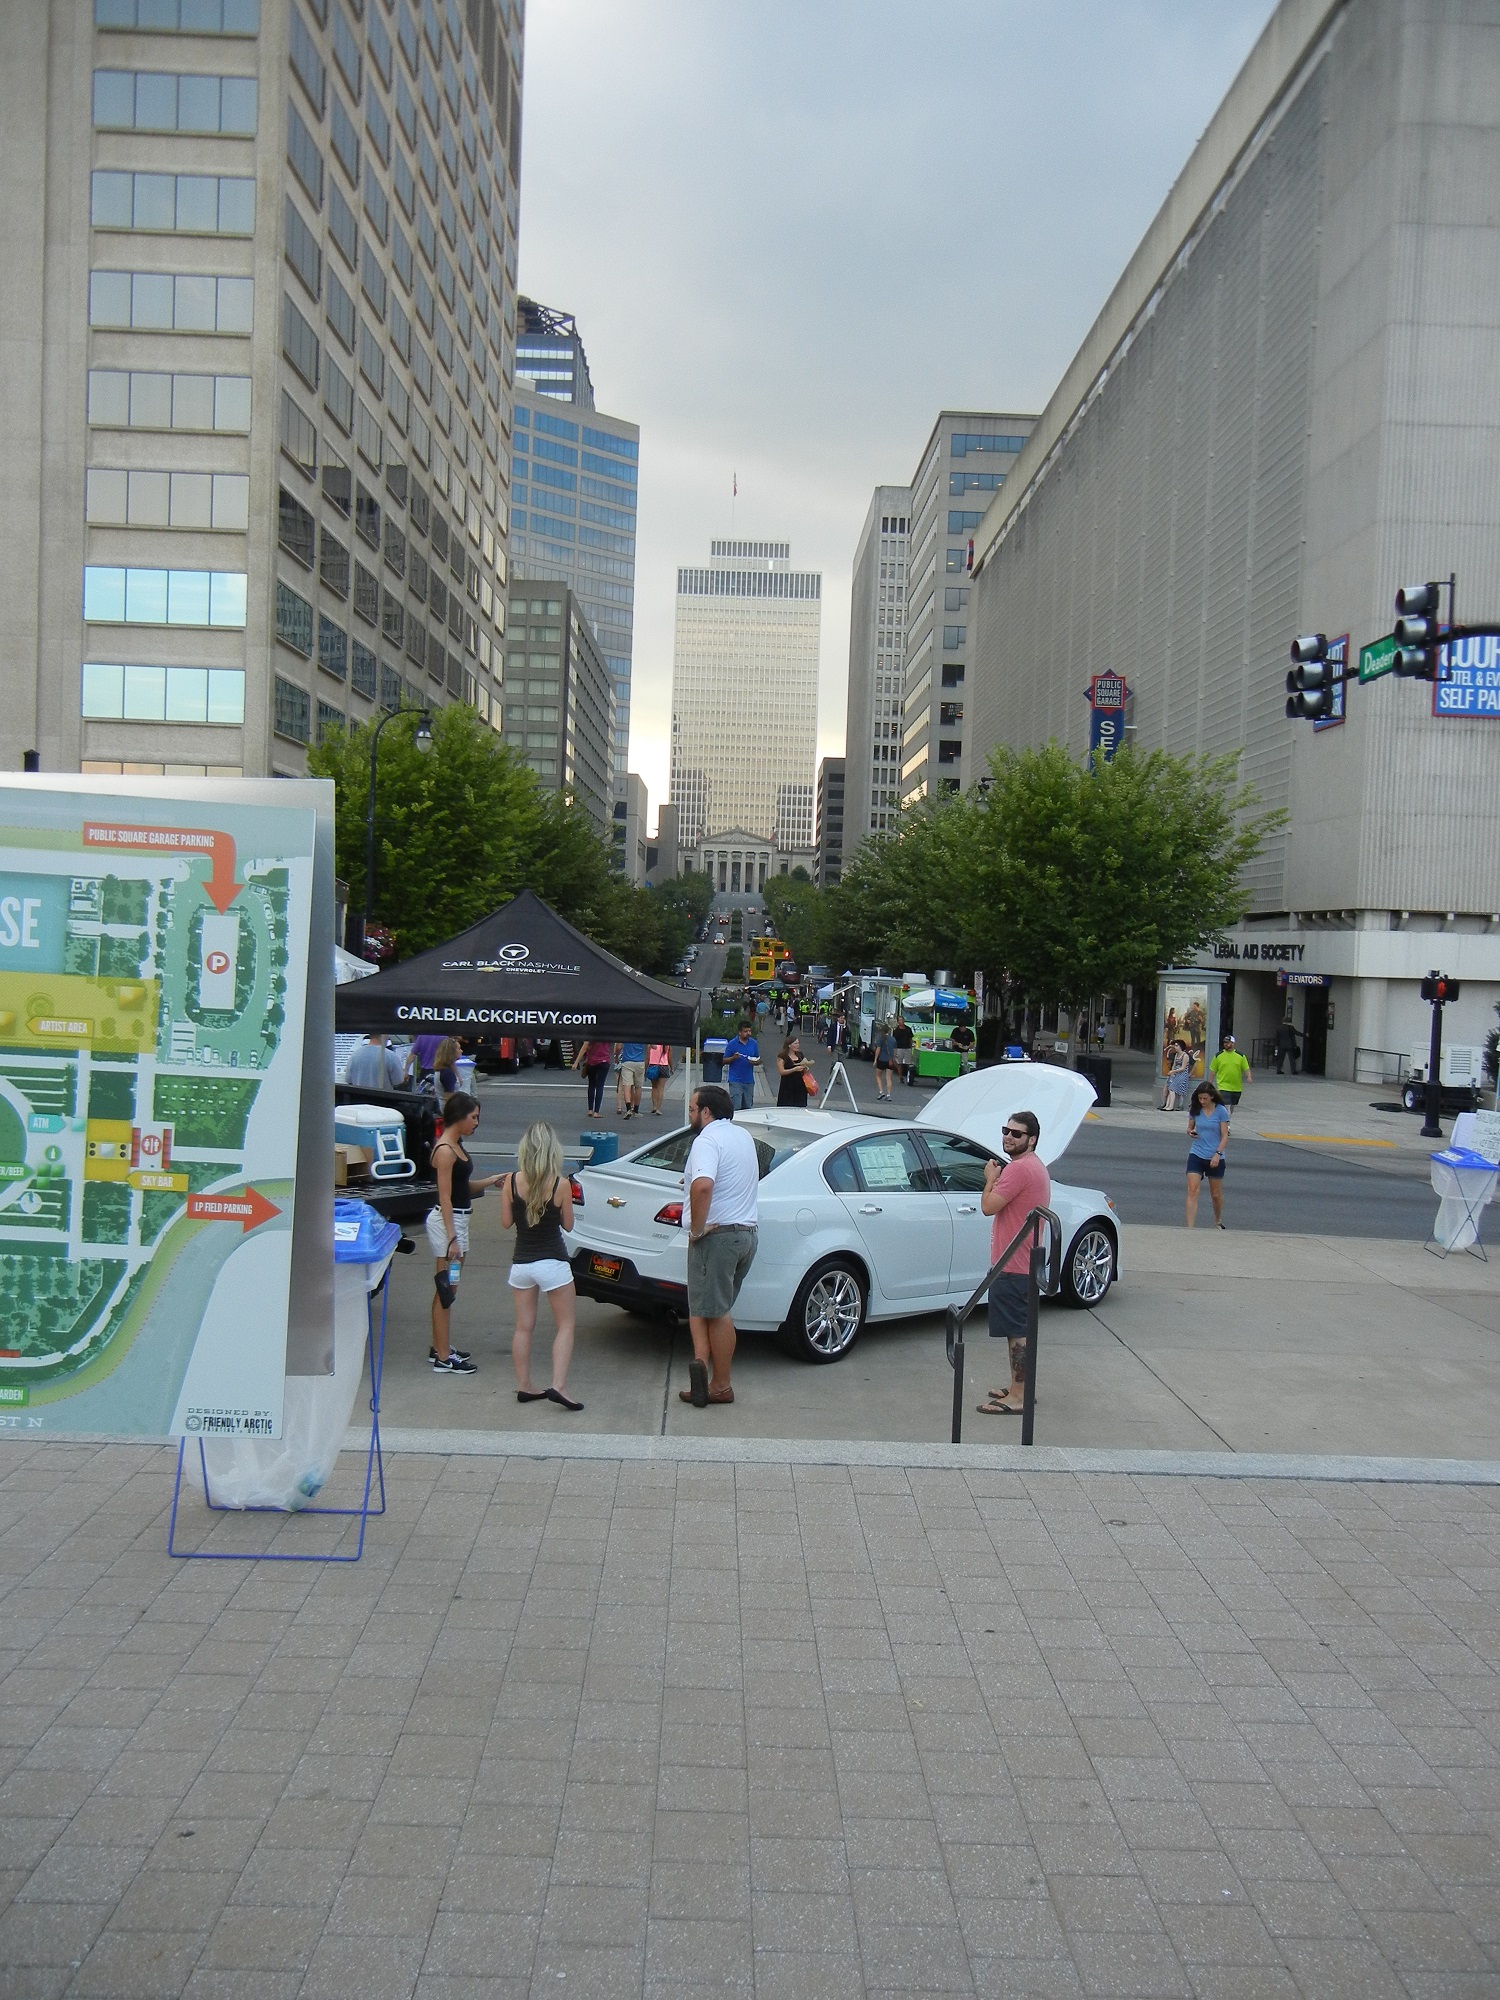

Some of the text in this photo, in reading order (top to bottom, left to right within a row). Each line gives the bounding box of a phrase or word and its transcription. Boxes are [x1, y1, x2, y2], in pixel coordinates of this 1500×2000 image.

[1364, 647, 1402, 675] Deaderi
[1097, 680, 1122, 689] PUBLIC
[1475, 671, 1484, 686] &
[1096, 688, 1121, 697] SQUARE
[1440, 687, 1500, 710] SELF PA
[1096, 697, 1121, 706] GARAGE
[89, 828, 215, 848] PUBLIC SQUARE GARAGE PARKING
[0, 896, 42, 948] SE
[1213, 943, 1305, 961] LEGAL AID SOCIETY
[518, 960, 581, 972] NASHVILLE
[1288, 974, 1324, 985] ELEVATORS
[396, 1005, 598, 1025] CARLBLACKCHEVY.com
[40, 1020, 88, 1034] ARTIST AREA
[32, 1117, 50, 1129] ATM
[141, 1175, 174, 1188] SKY BAR
[194, 1202, 253, 1215] LP FIELD PARKING
[187, 1407, 249, 1416] DESIGNED
[26, 1417, 44, 1428] N
[203, 1416, 273, 1430] FRIENDLY ARCTIC
